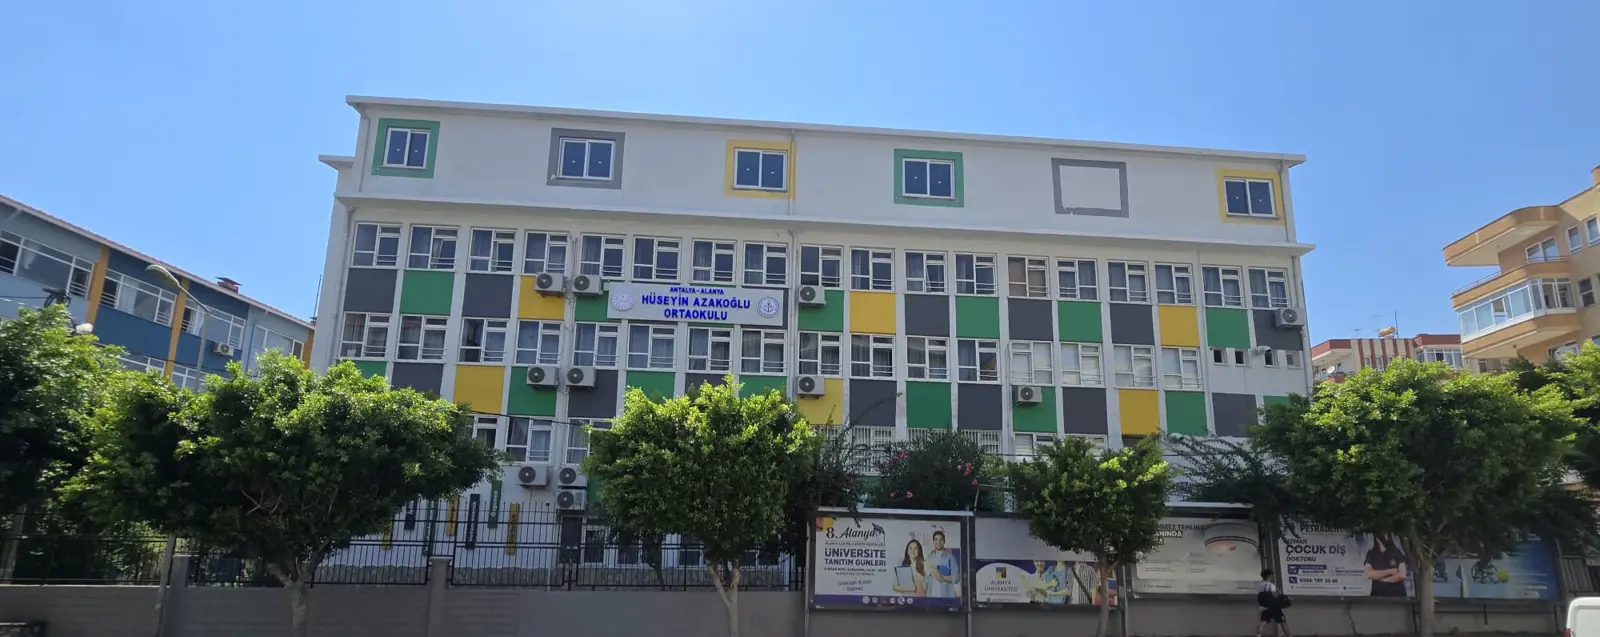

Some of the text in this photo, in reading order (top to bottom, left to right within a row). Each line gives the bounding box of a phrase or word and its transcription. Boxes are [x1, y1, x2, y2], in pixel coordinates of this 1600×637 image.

[669, 286, 696, 294] ANTALYA
[700, 287, 724, 295] ALANYA
[641, 292, 689, 306] HÜSEYİN
[693, 297, 751, 309] AZAKOĞLU
[664, 308, 728, 320] ORTAOKULU
[826, 527, 876, 541] 8. Alanya
[824, 547, 886, 558] ÜNİVERSİTE
[1286, 544, 1346, 556] ÇOCUK DİŞ
[824, 558, 854, 566] TANITIM
